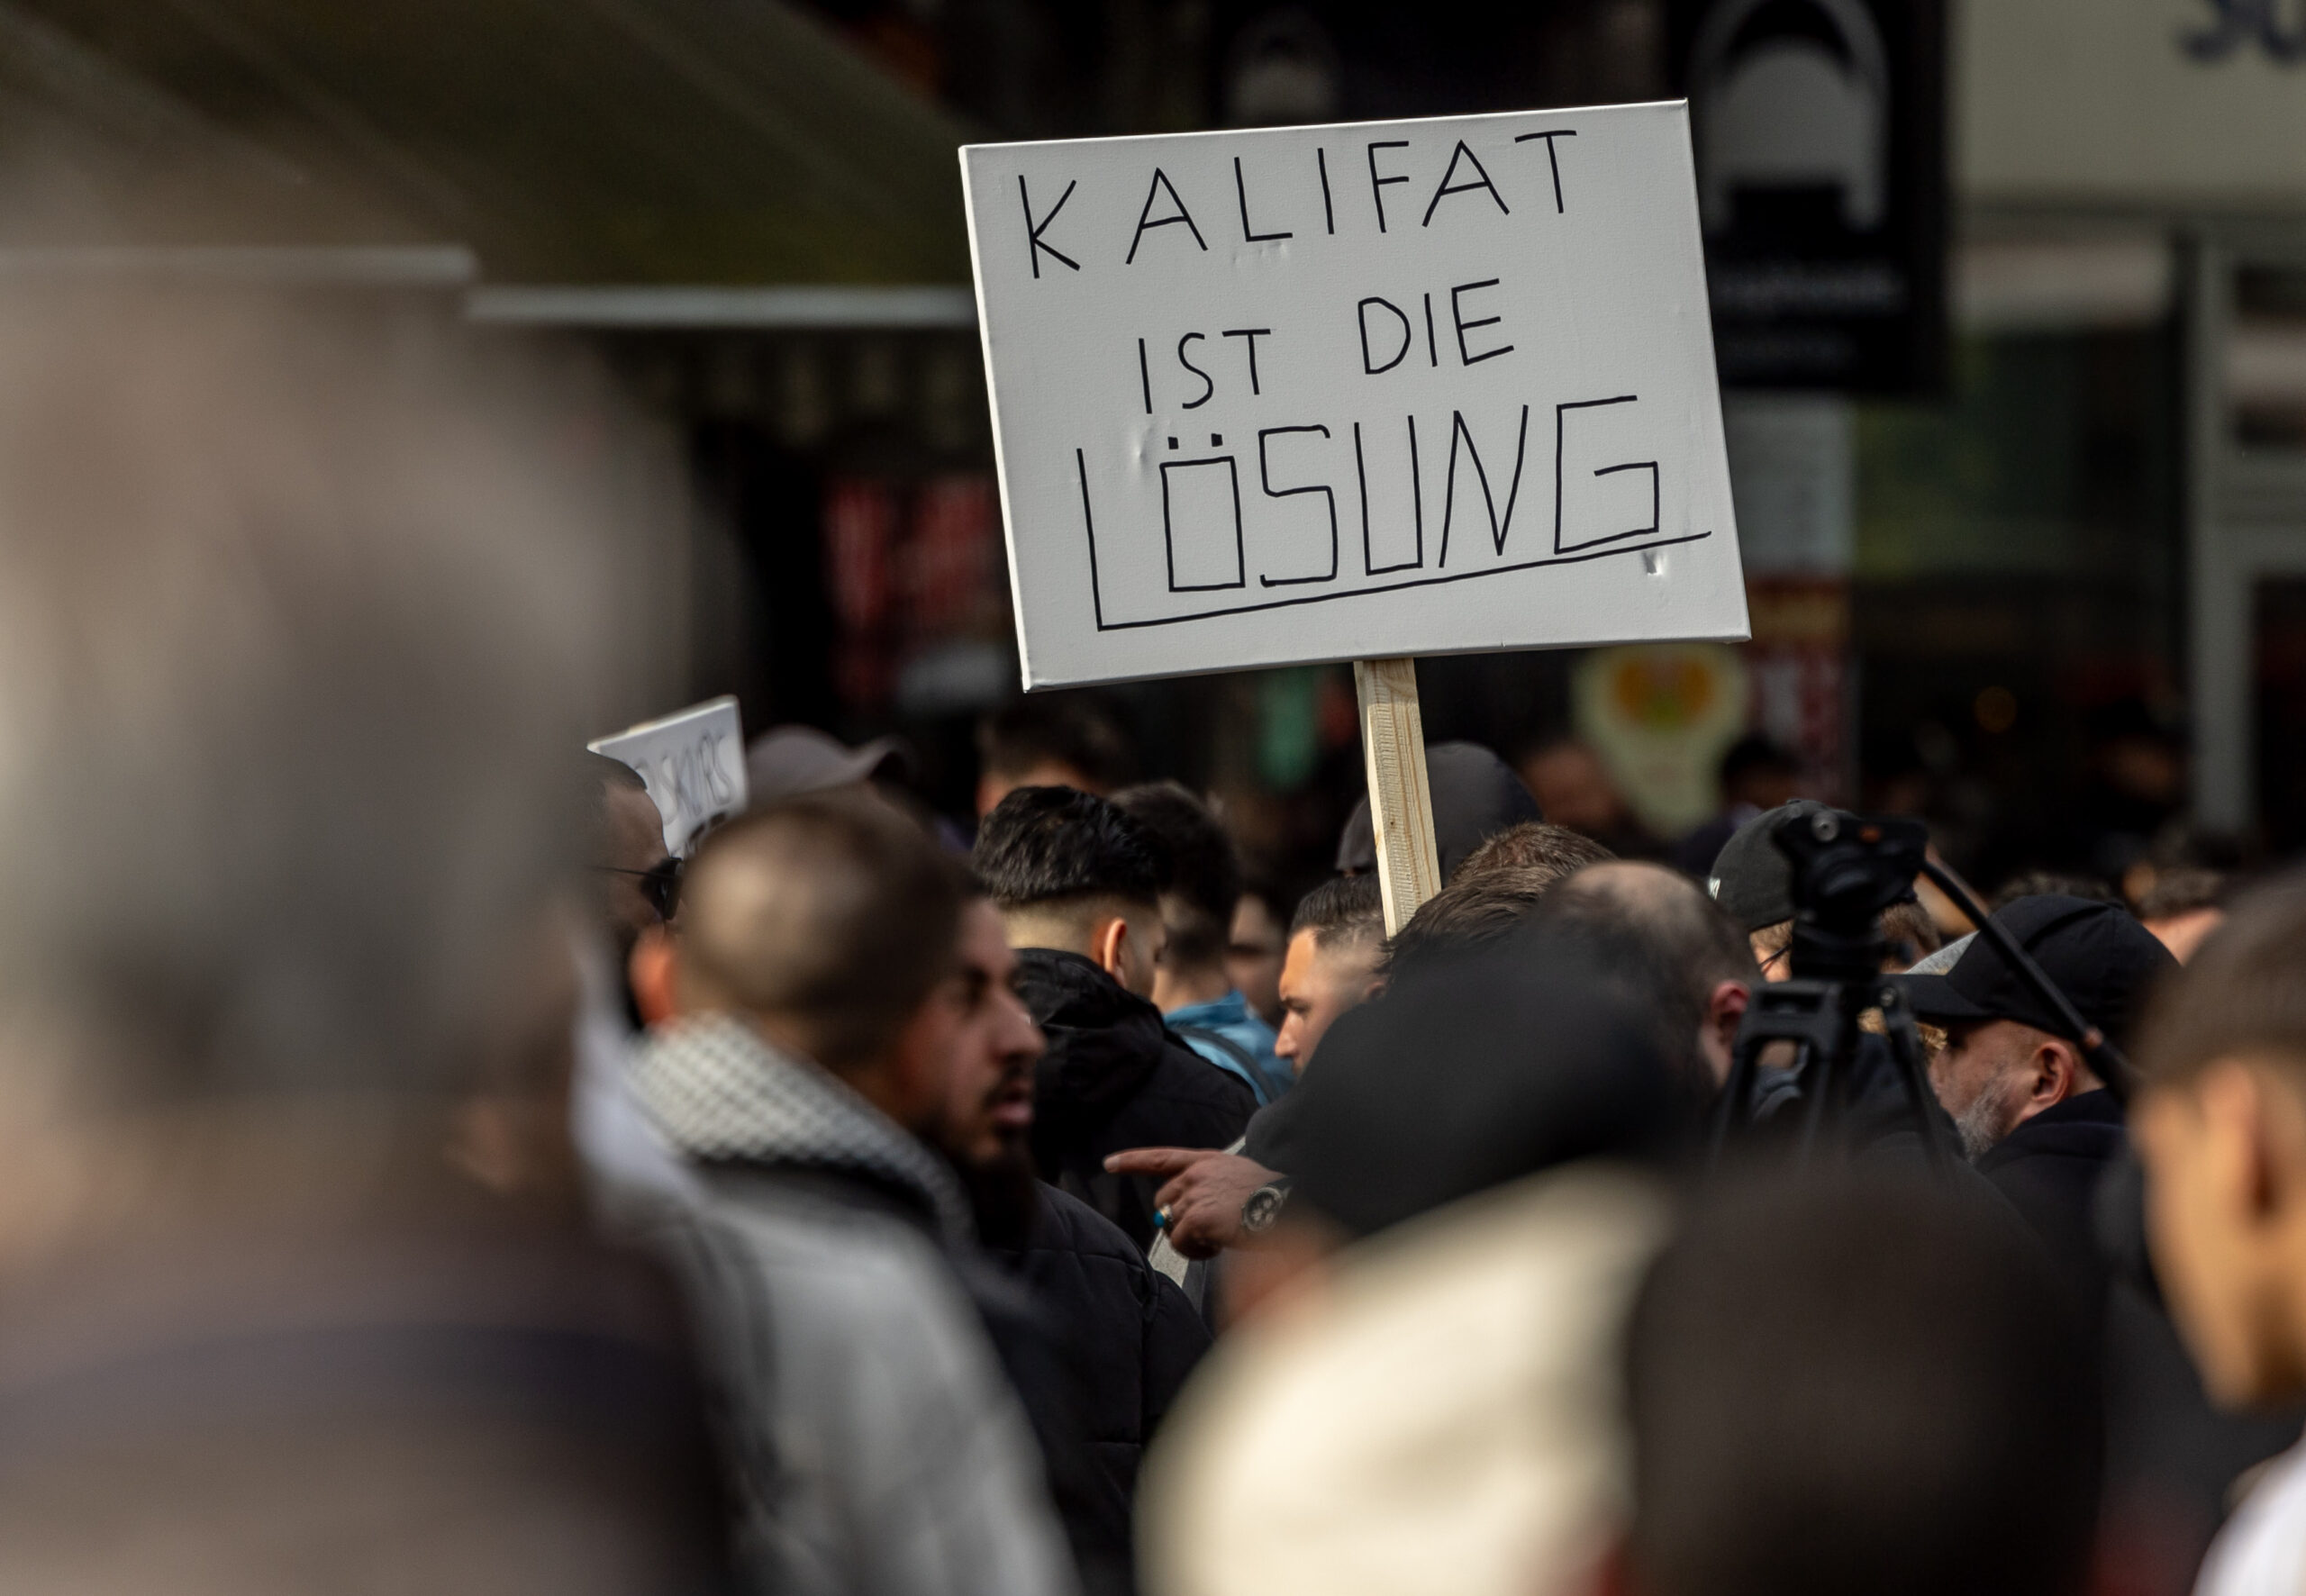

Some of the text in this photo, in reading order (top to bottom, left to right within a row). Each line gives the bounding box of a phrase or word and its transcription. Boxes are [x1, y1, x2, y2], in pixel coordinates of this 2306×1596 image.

[1018, 129, 1578, 279] KALIFAT
[1138, 277, 1515, 414] IST DIE
[1076, 394, 1712, 632] LÖSUNG
